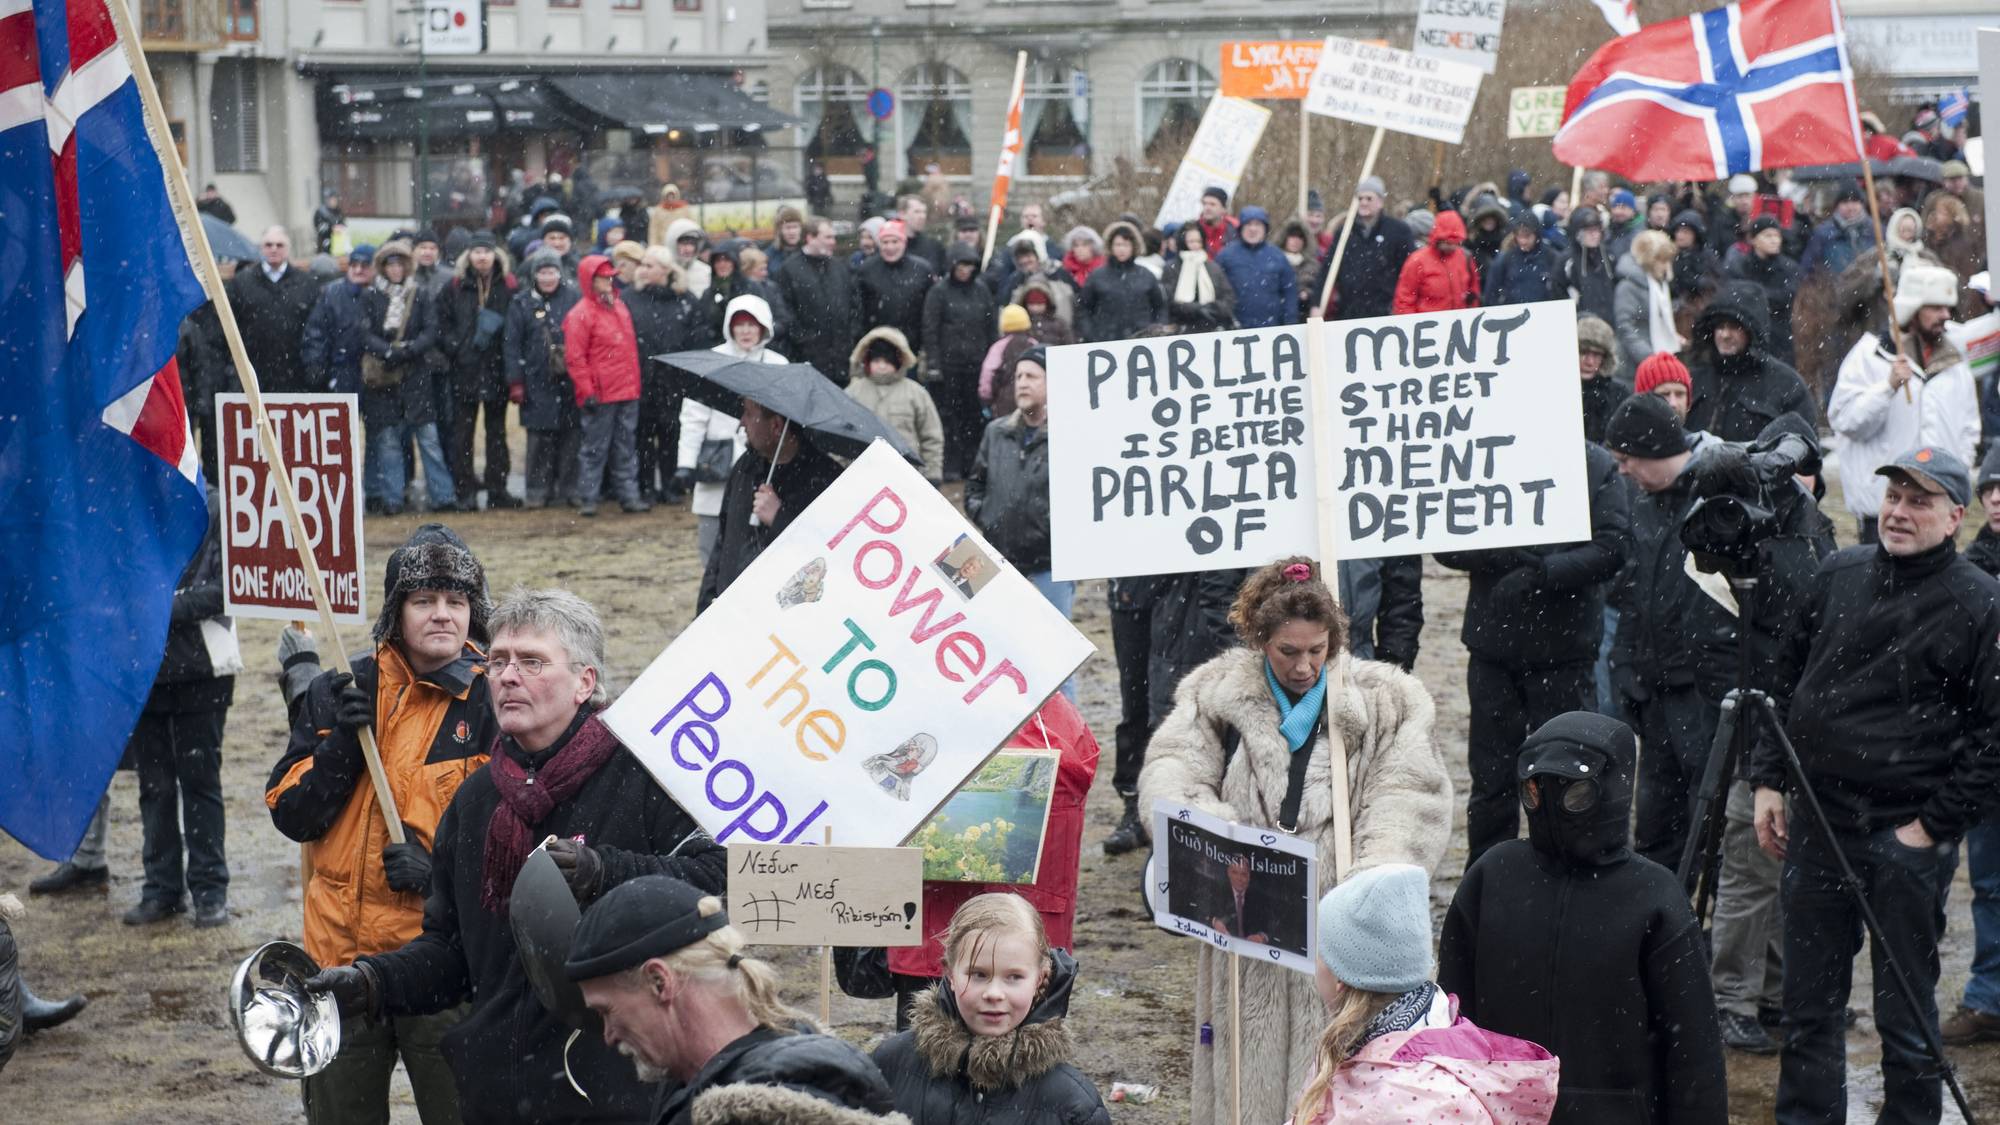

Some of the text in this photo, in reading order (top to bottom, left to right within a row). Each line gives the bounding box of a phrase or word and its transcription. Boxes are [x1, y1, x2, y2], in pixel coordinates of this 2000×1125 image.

[1088, 309, 1531, 410] PARLIA MENT
[292, 408, 342, 465] ME
[1121, 405, 1474, 459] IS BETTER THAN
[1152, 372, 1498, 427] OF THE STREET
[229, 465, 346, 557] BABY
[1093, 435, 1515, 522] PARLIA MENT
[1186, 478, 1556, 555] OF DEFEAT
[232, 564, 358, 607] ONE MORE TIME
[745, 633, 847, 762] The
[650, 672, 828, 845] Peopl
[1172, 825, 1297, 876] Guð blessi Ísland
